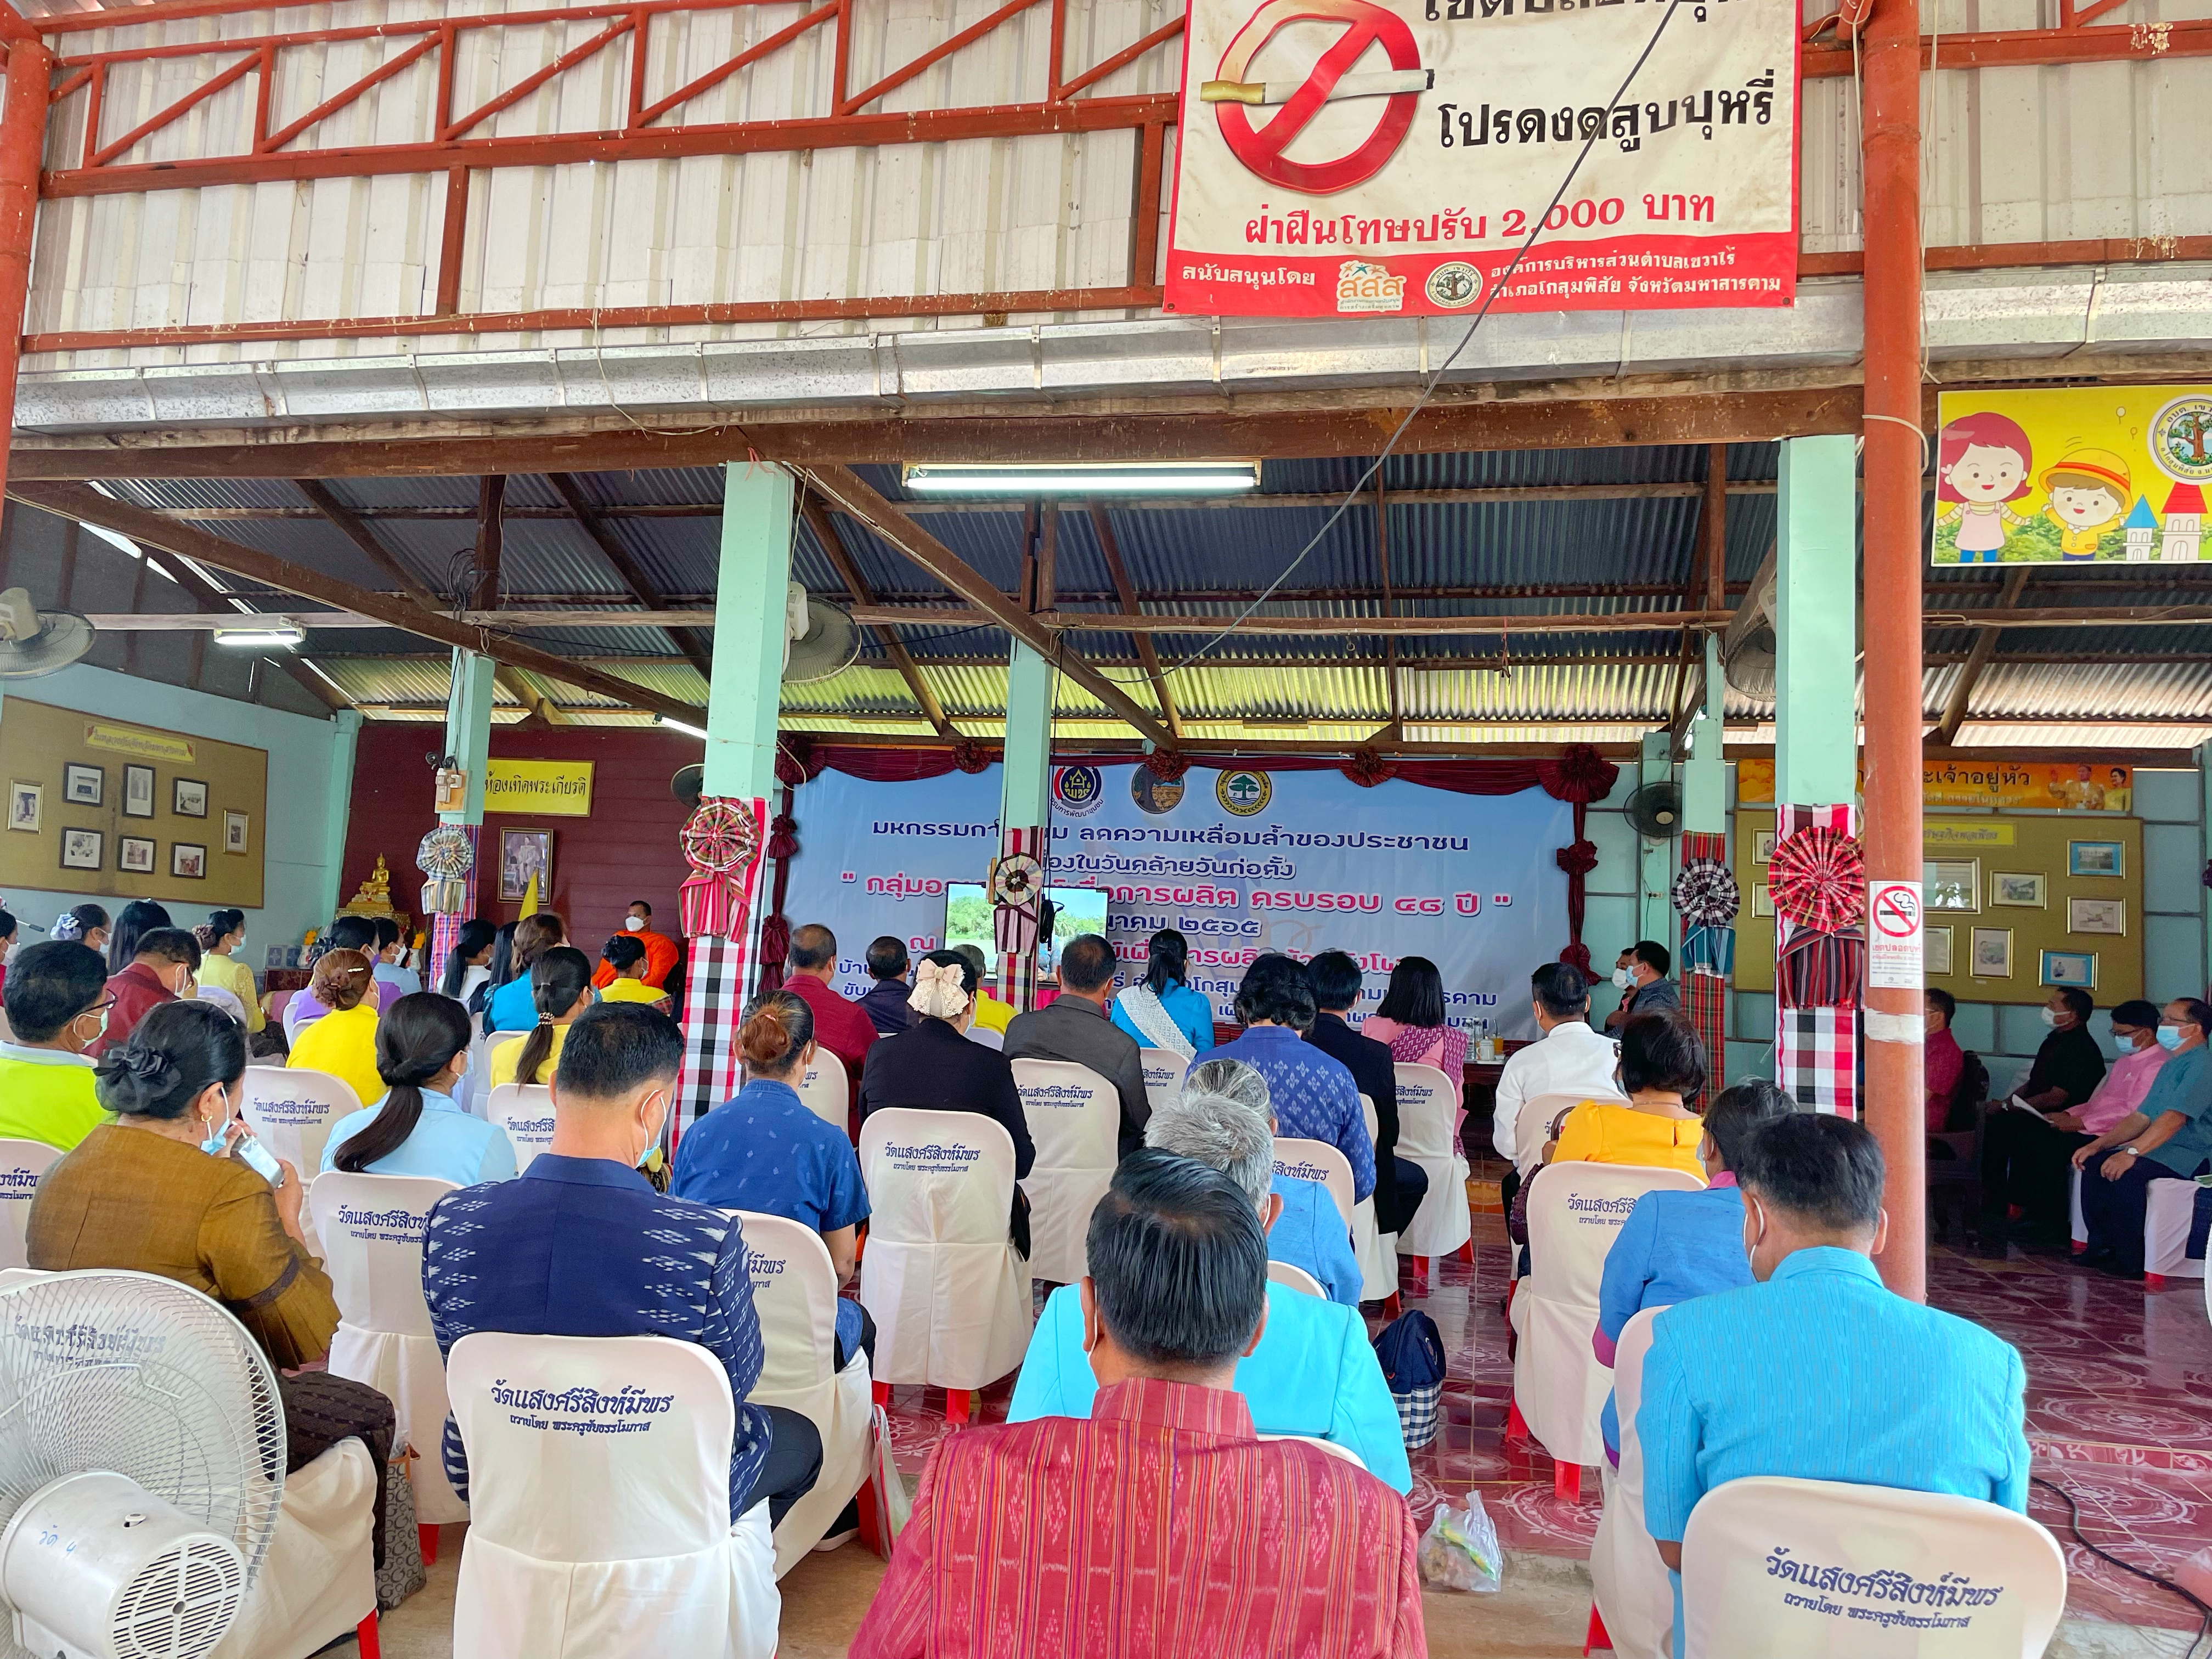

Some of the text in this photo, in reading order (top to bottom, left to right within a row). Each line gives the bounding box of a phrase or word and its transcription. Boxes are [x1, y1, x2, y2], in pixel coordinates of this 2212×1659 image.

[1437, 69, 1774, 153] โปรดงดสูบบุหรี่
[1245, 204, 1486, 245] ฝ่าฝืนโทษปรับ
[1643, 193, 1714, 222] บาท
[1183, 263, 1316, 290] สนับสนุนโดย
[1339, 275, 1404, 298] สสส
[1628, 275, 1781, 294] จังหวัดมหาสารคาม
[1080, 824, 1469, 850] ลดความเหลื่อมล้ำของประชาชน
[1252, 891, 1379, 911] ครบรอบ
[1455, 893, 1479, 913] ปี
